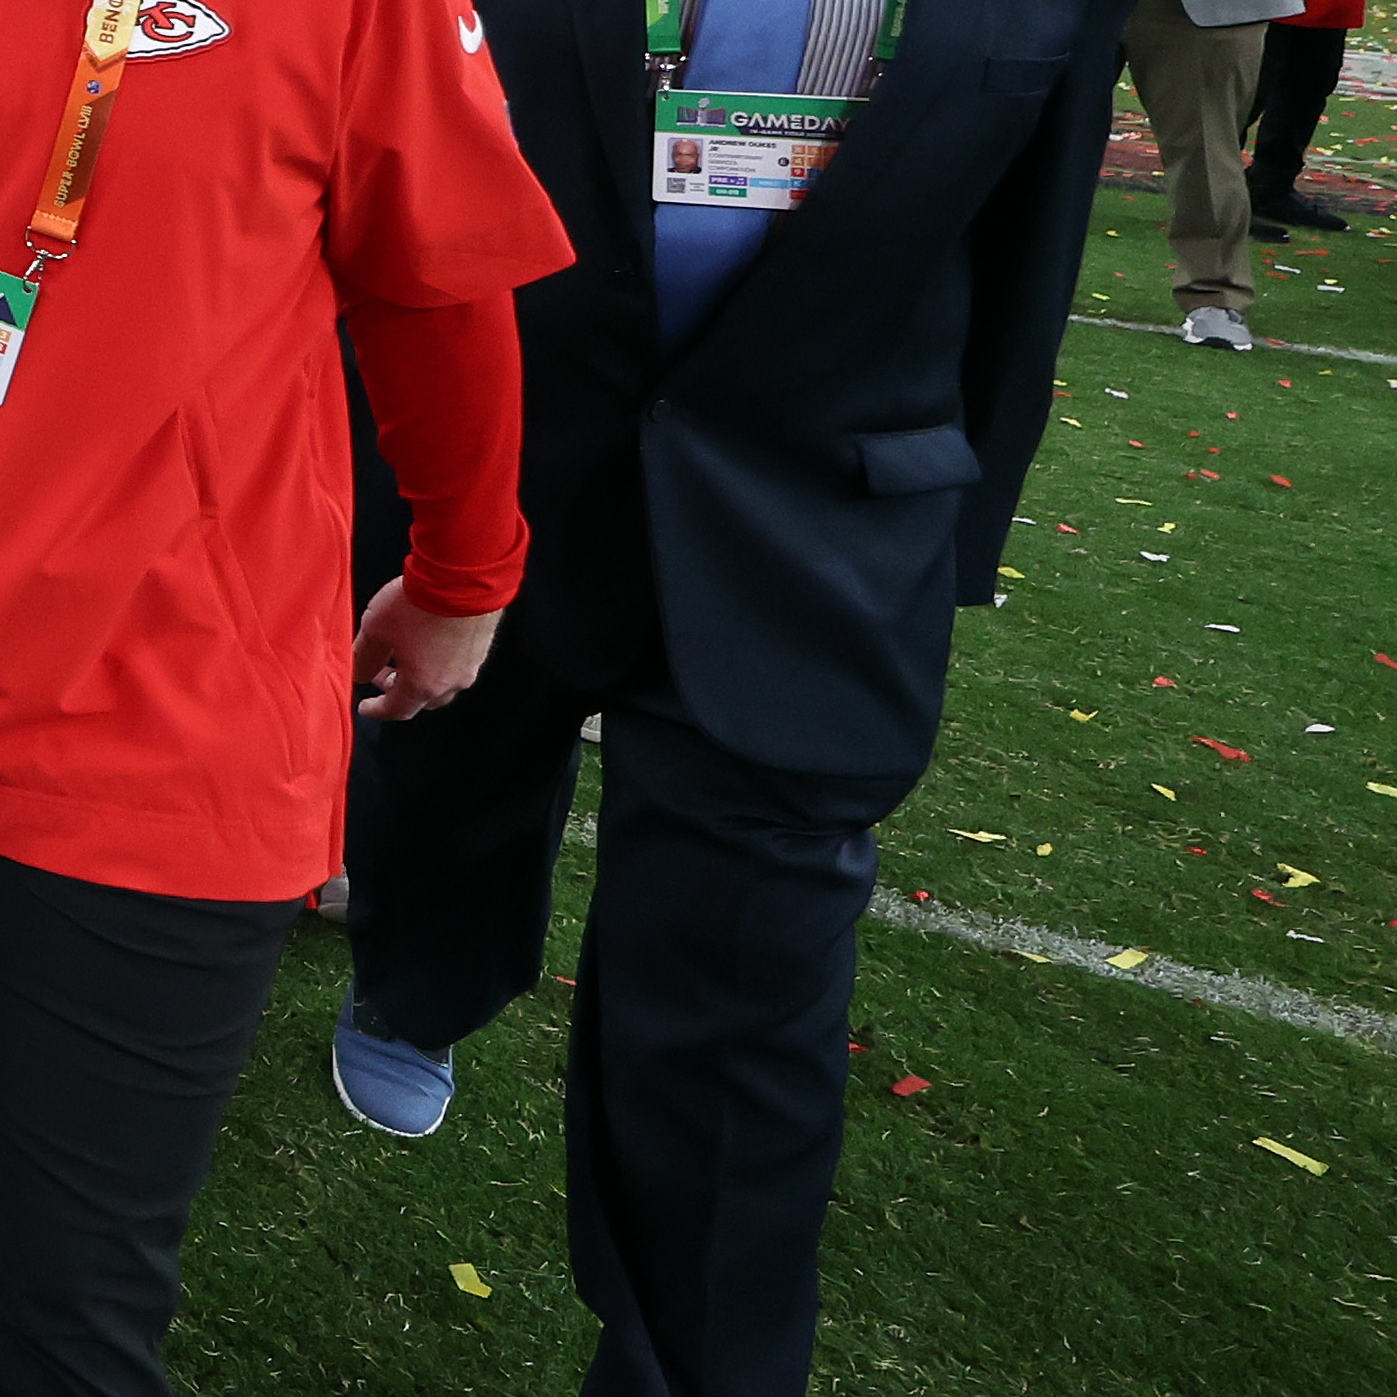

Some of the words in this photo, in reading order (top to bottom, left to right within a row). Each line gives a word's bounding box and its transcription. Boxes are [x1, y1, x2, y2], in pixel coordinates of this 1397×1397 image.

[730, 111, 850, 131] GAMEDAY
[54, 168, 74, 209] SUPER
[64, 131, 85, 169] BOWL
